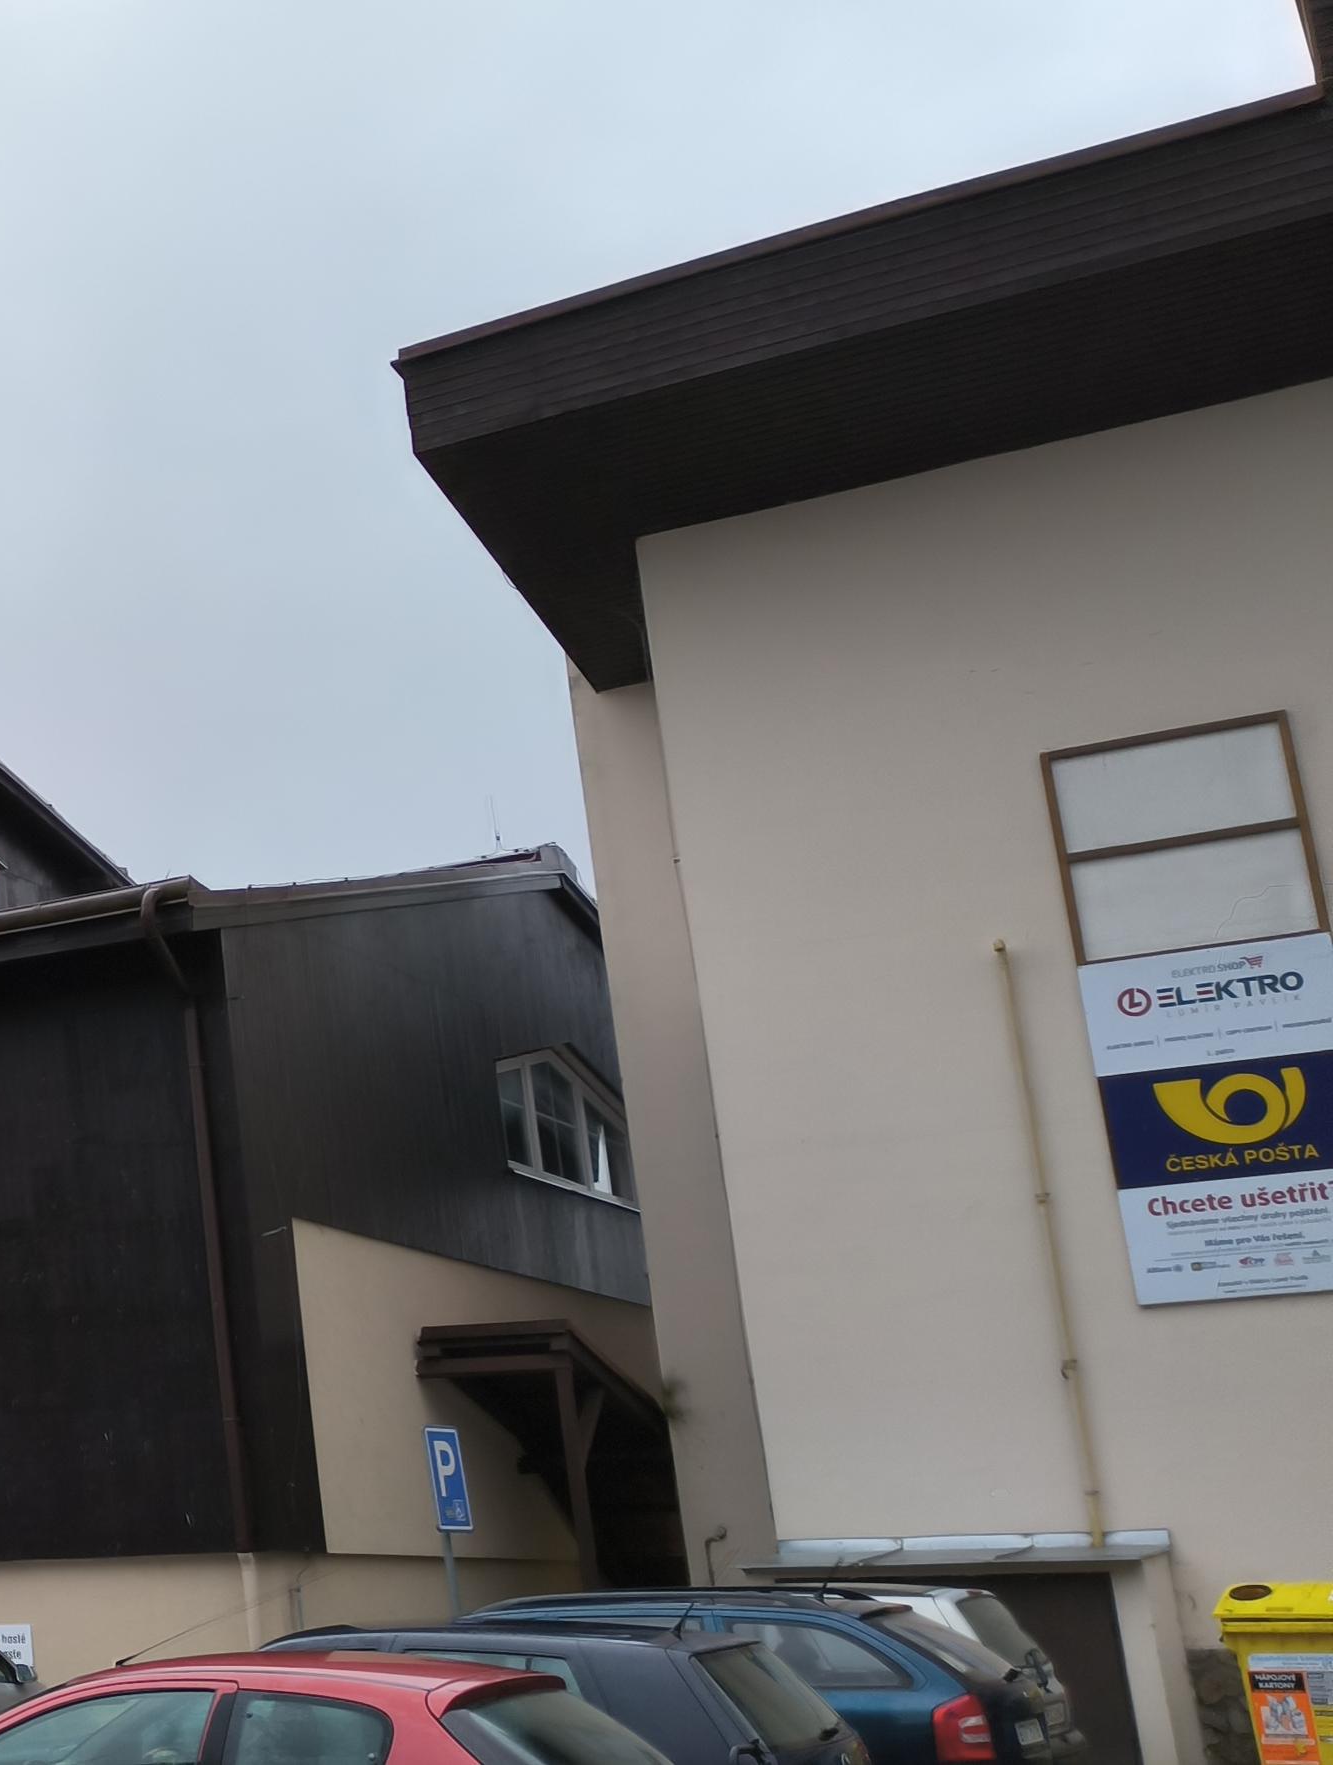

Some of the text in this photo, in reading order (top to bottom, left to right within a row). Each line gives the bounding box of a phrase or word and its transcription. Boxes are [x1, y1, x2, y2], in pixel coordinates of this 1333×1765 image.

[1156, 971, 1304, 1009] ELEKTRO
[1165, 1142, 1320, 1172] ČESKÁ POŠTA
[1147, 1192, 1233, 1217] Chcete
[433, 1440, 456, 1497] P
